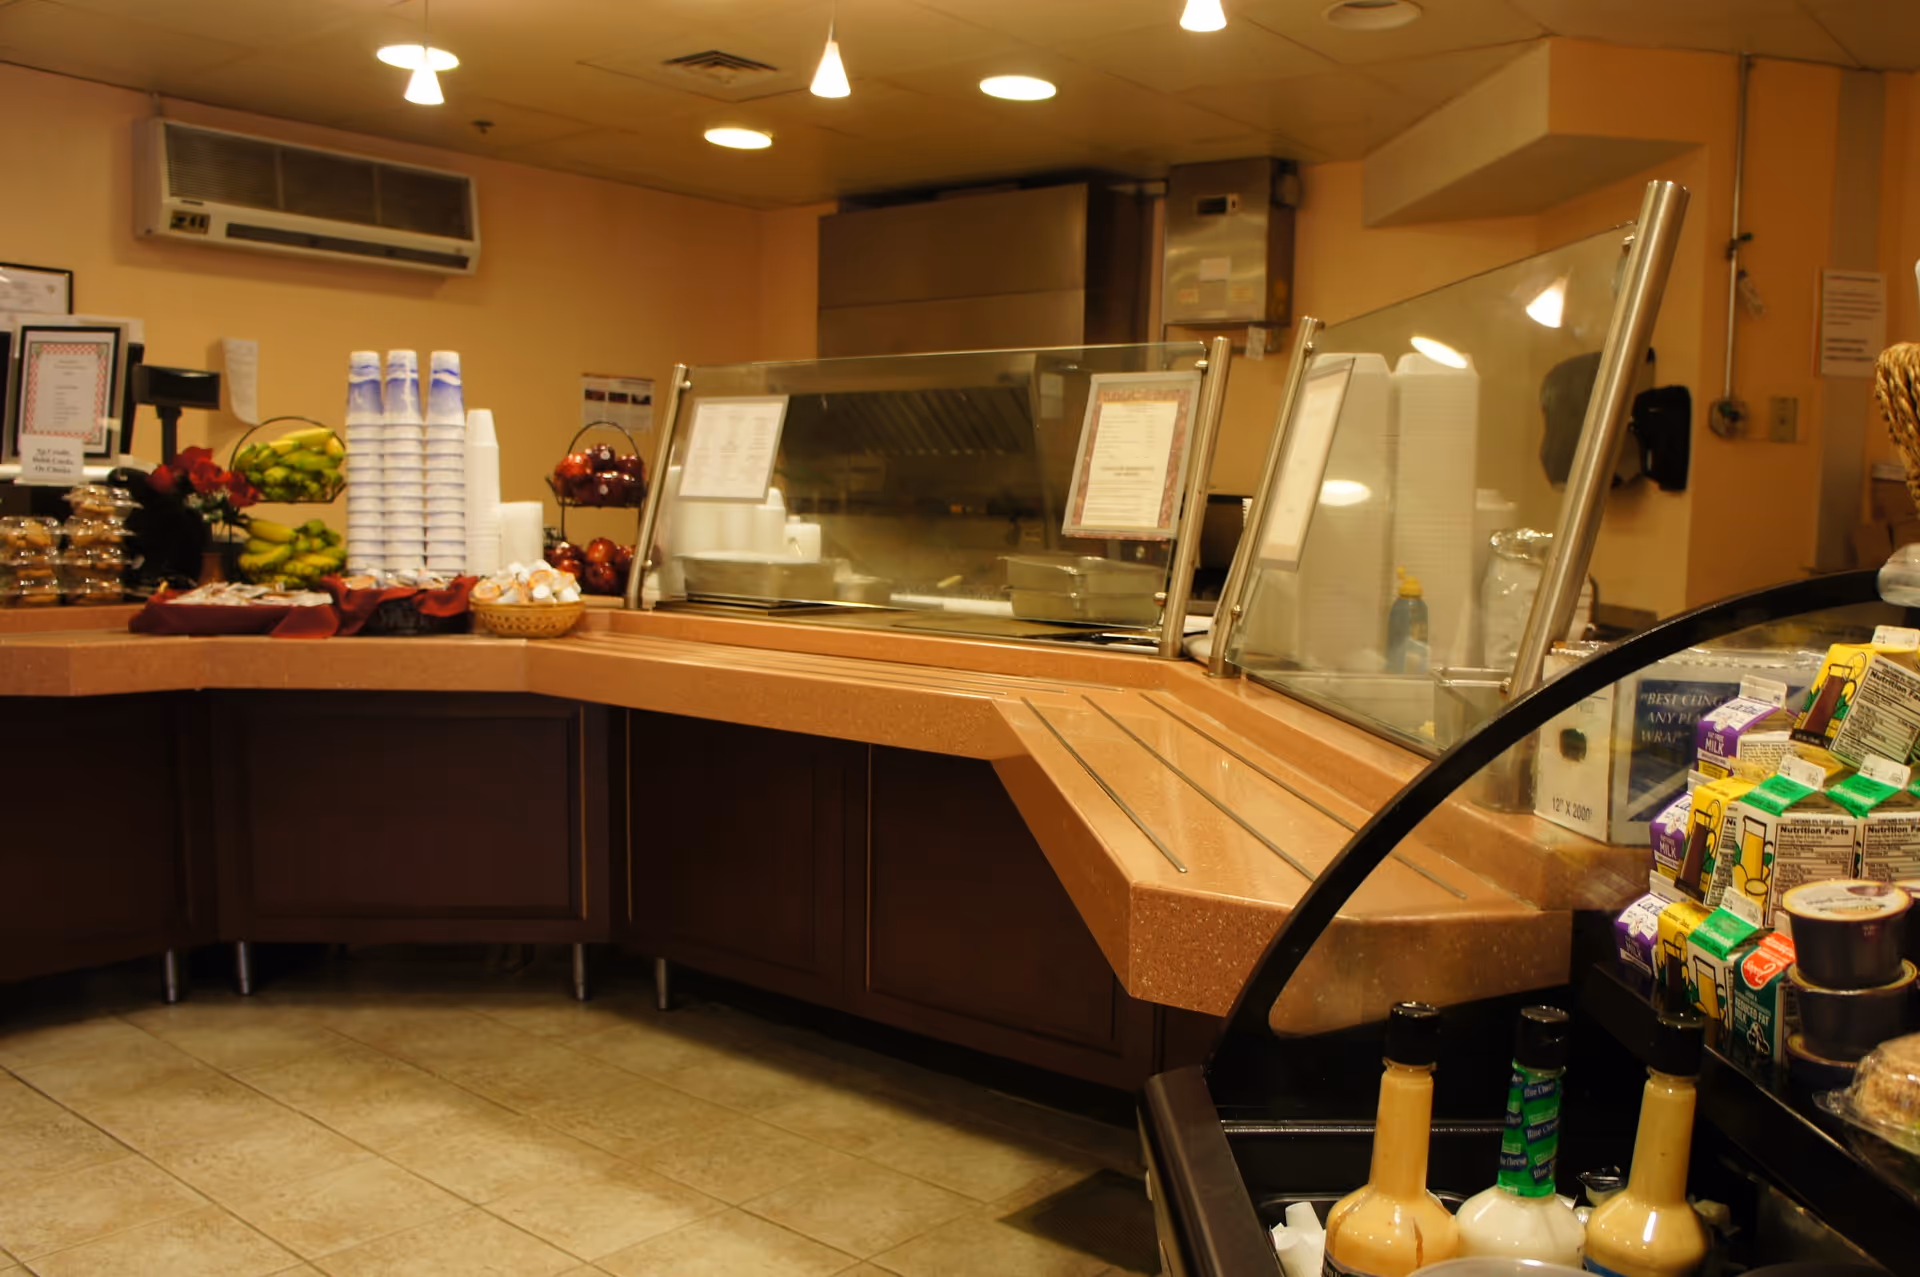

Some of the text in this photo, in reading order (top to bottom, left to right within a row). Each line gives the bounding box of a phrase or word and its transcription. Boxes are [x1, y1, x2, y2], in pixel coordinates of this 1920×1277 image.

[1648, 711, 1678, 725] ANY
[1705, 737, 1725, 756] MILK
[1565, 800, 1571, 817] X
[1780, 826, 1849, 836] Nutrition Facts
[1867, 826, 1908, 834] Nutrition
[1659, 840, 1677, 860] MILK
[1758, 1011, 1770, 1027] FAT
